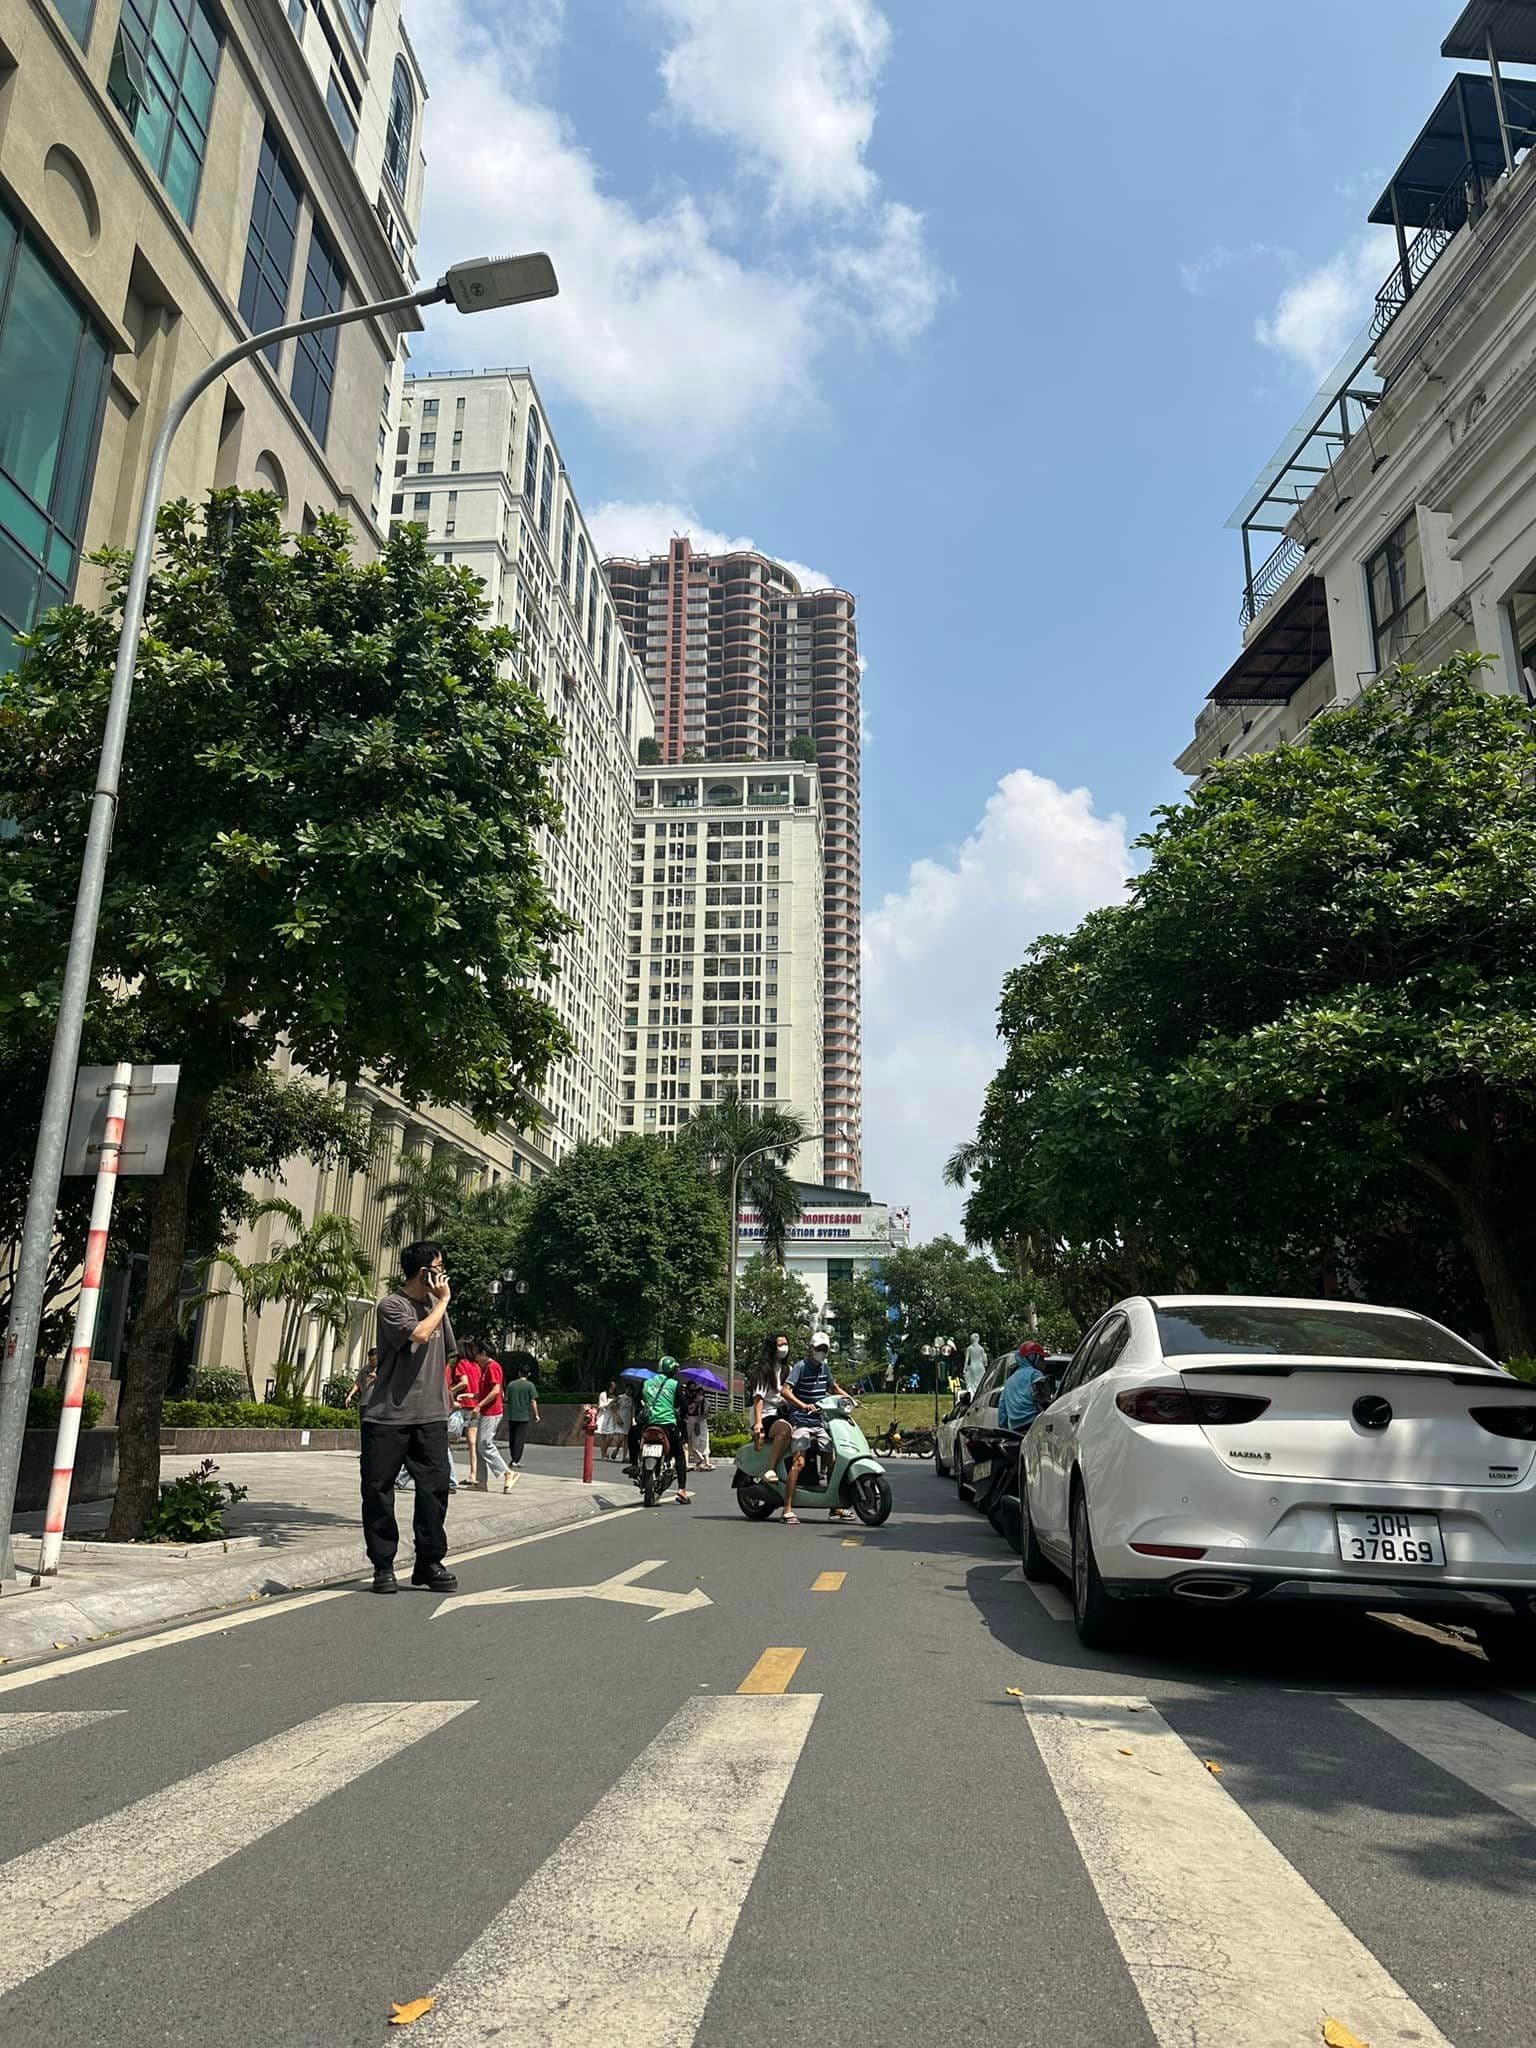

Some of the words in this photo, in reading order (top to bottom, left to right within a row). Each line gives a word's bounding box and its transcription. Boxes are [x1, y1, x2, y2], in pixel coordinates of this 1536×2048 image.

[802, 1213, 862, 1224] MONTESSORI
[817, 1228, 850, 1237] SYSTEM
[1229, 1450, 1262, 1459] MAZDA
[1264, 1451, 1272, 1461] 3
[1366, 1514, 1411, 1537] 30H
[1351, 1537, 1433, 1563] 378.69
